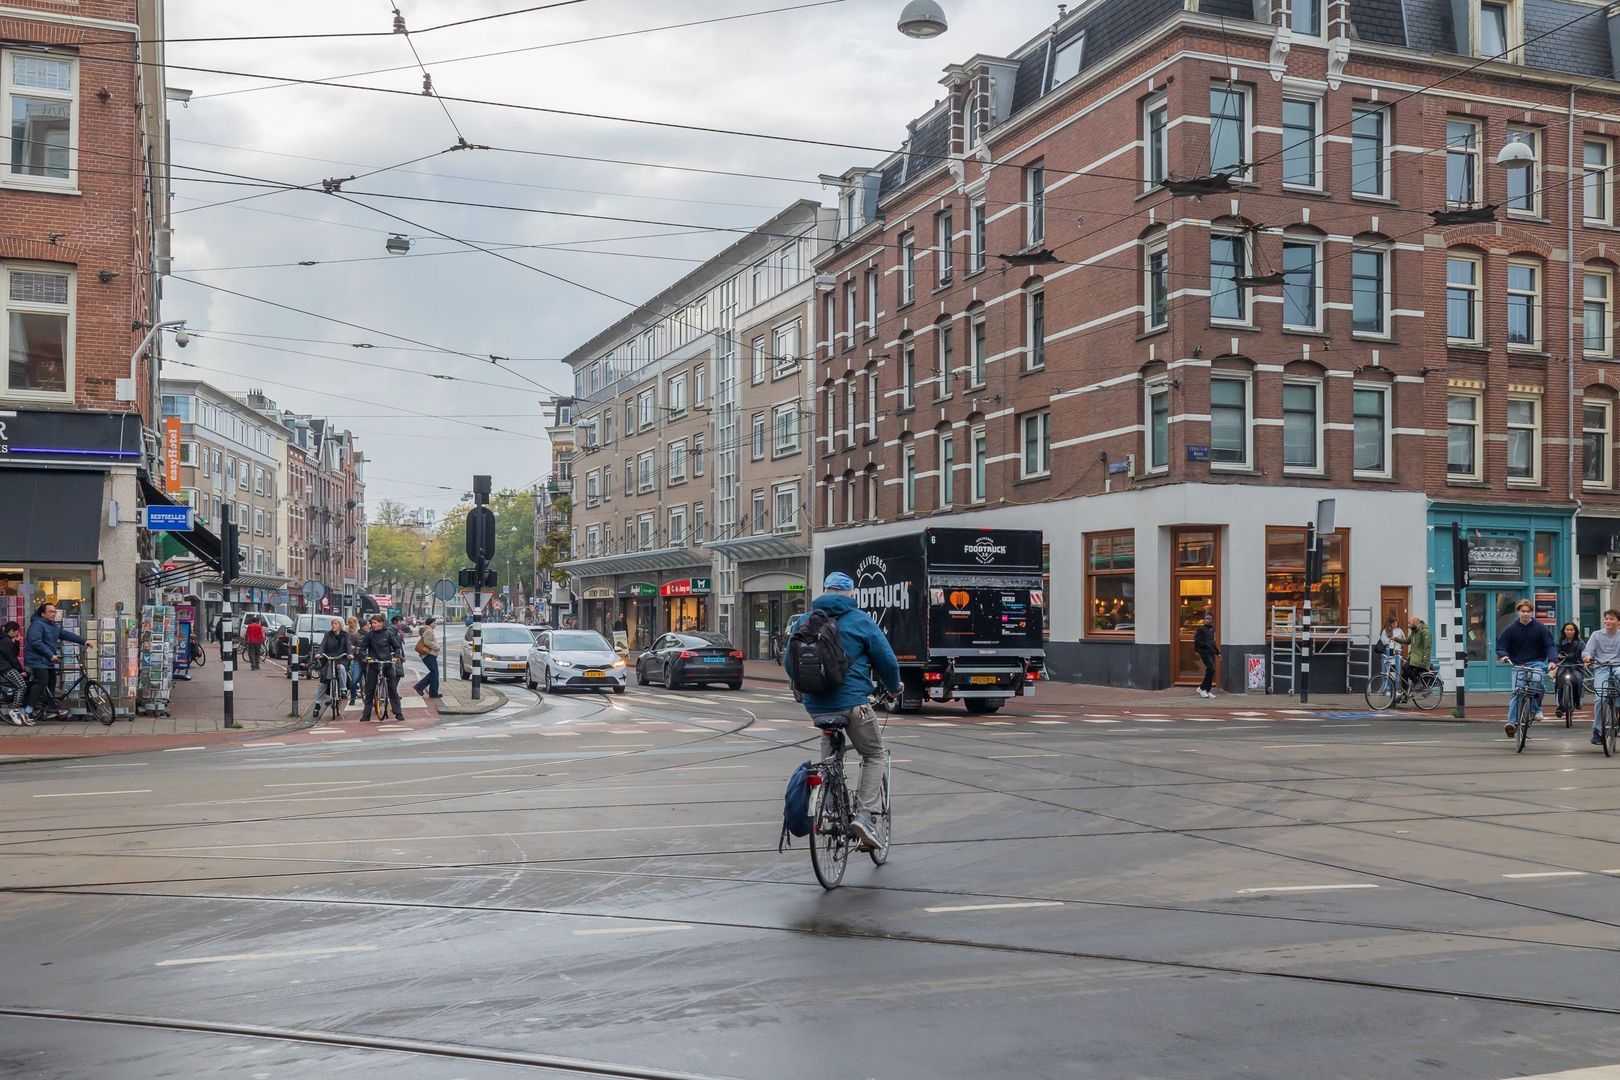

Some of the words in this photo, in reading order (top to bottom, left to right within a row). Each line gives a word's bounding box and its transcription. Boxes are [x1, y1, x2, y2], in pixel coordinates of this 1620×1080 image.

[168, 430, 179, 481] easyHotel
[931, 535, 936, 544] 6
[964, 545, 1006, 554] FOODTRUCK
[857, 555, 887, 577] DELIVERED
